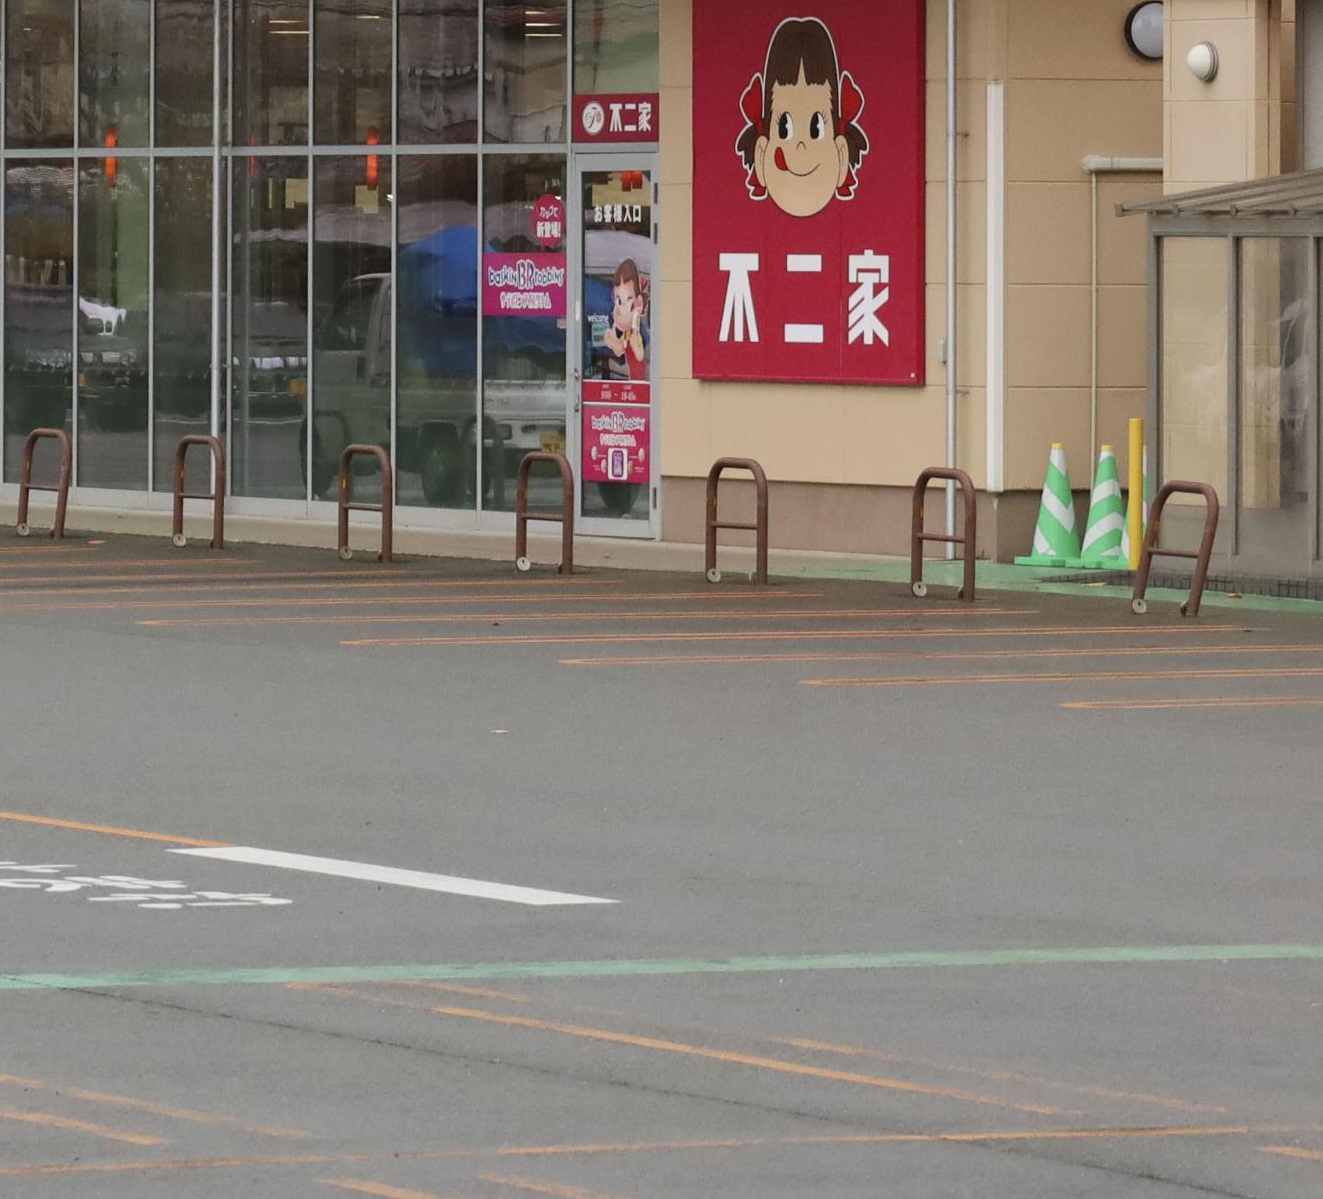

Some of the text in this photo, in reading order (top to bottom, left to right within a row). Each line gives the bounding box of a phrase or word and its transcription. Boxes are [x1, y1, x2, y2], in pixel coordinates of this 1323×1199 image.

[609, 102, 652, 132] 不二家
[593, 204, 642, 223] お客様入口
[488, 265, 518, 288] baskin
[534, 266, 564, 287] robbins
[718, 249, 889, 347] 不二家
